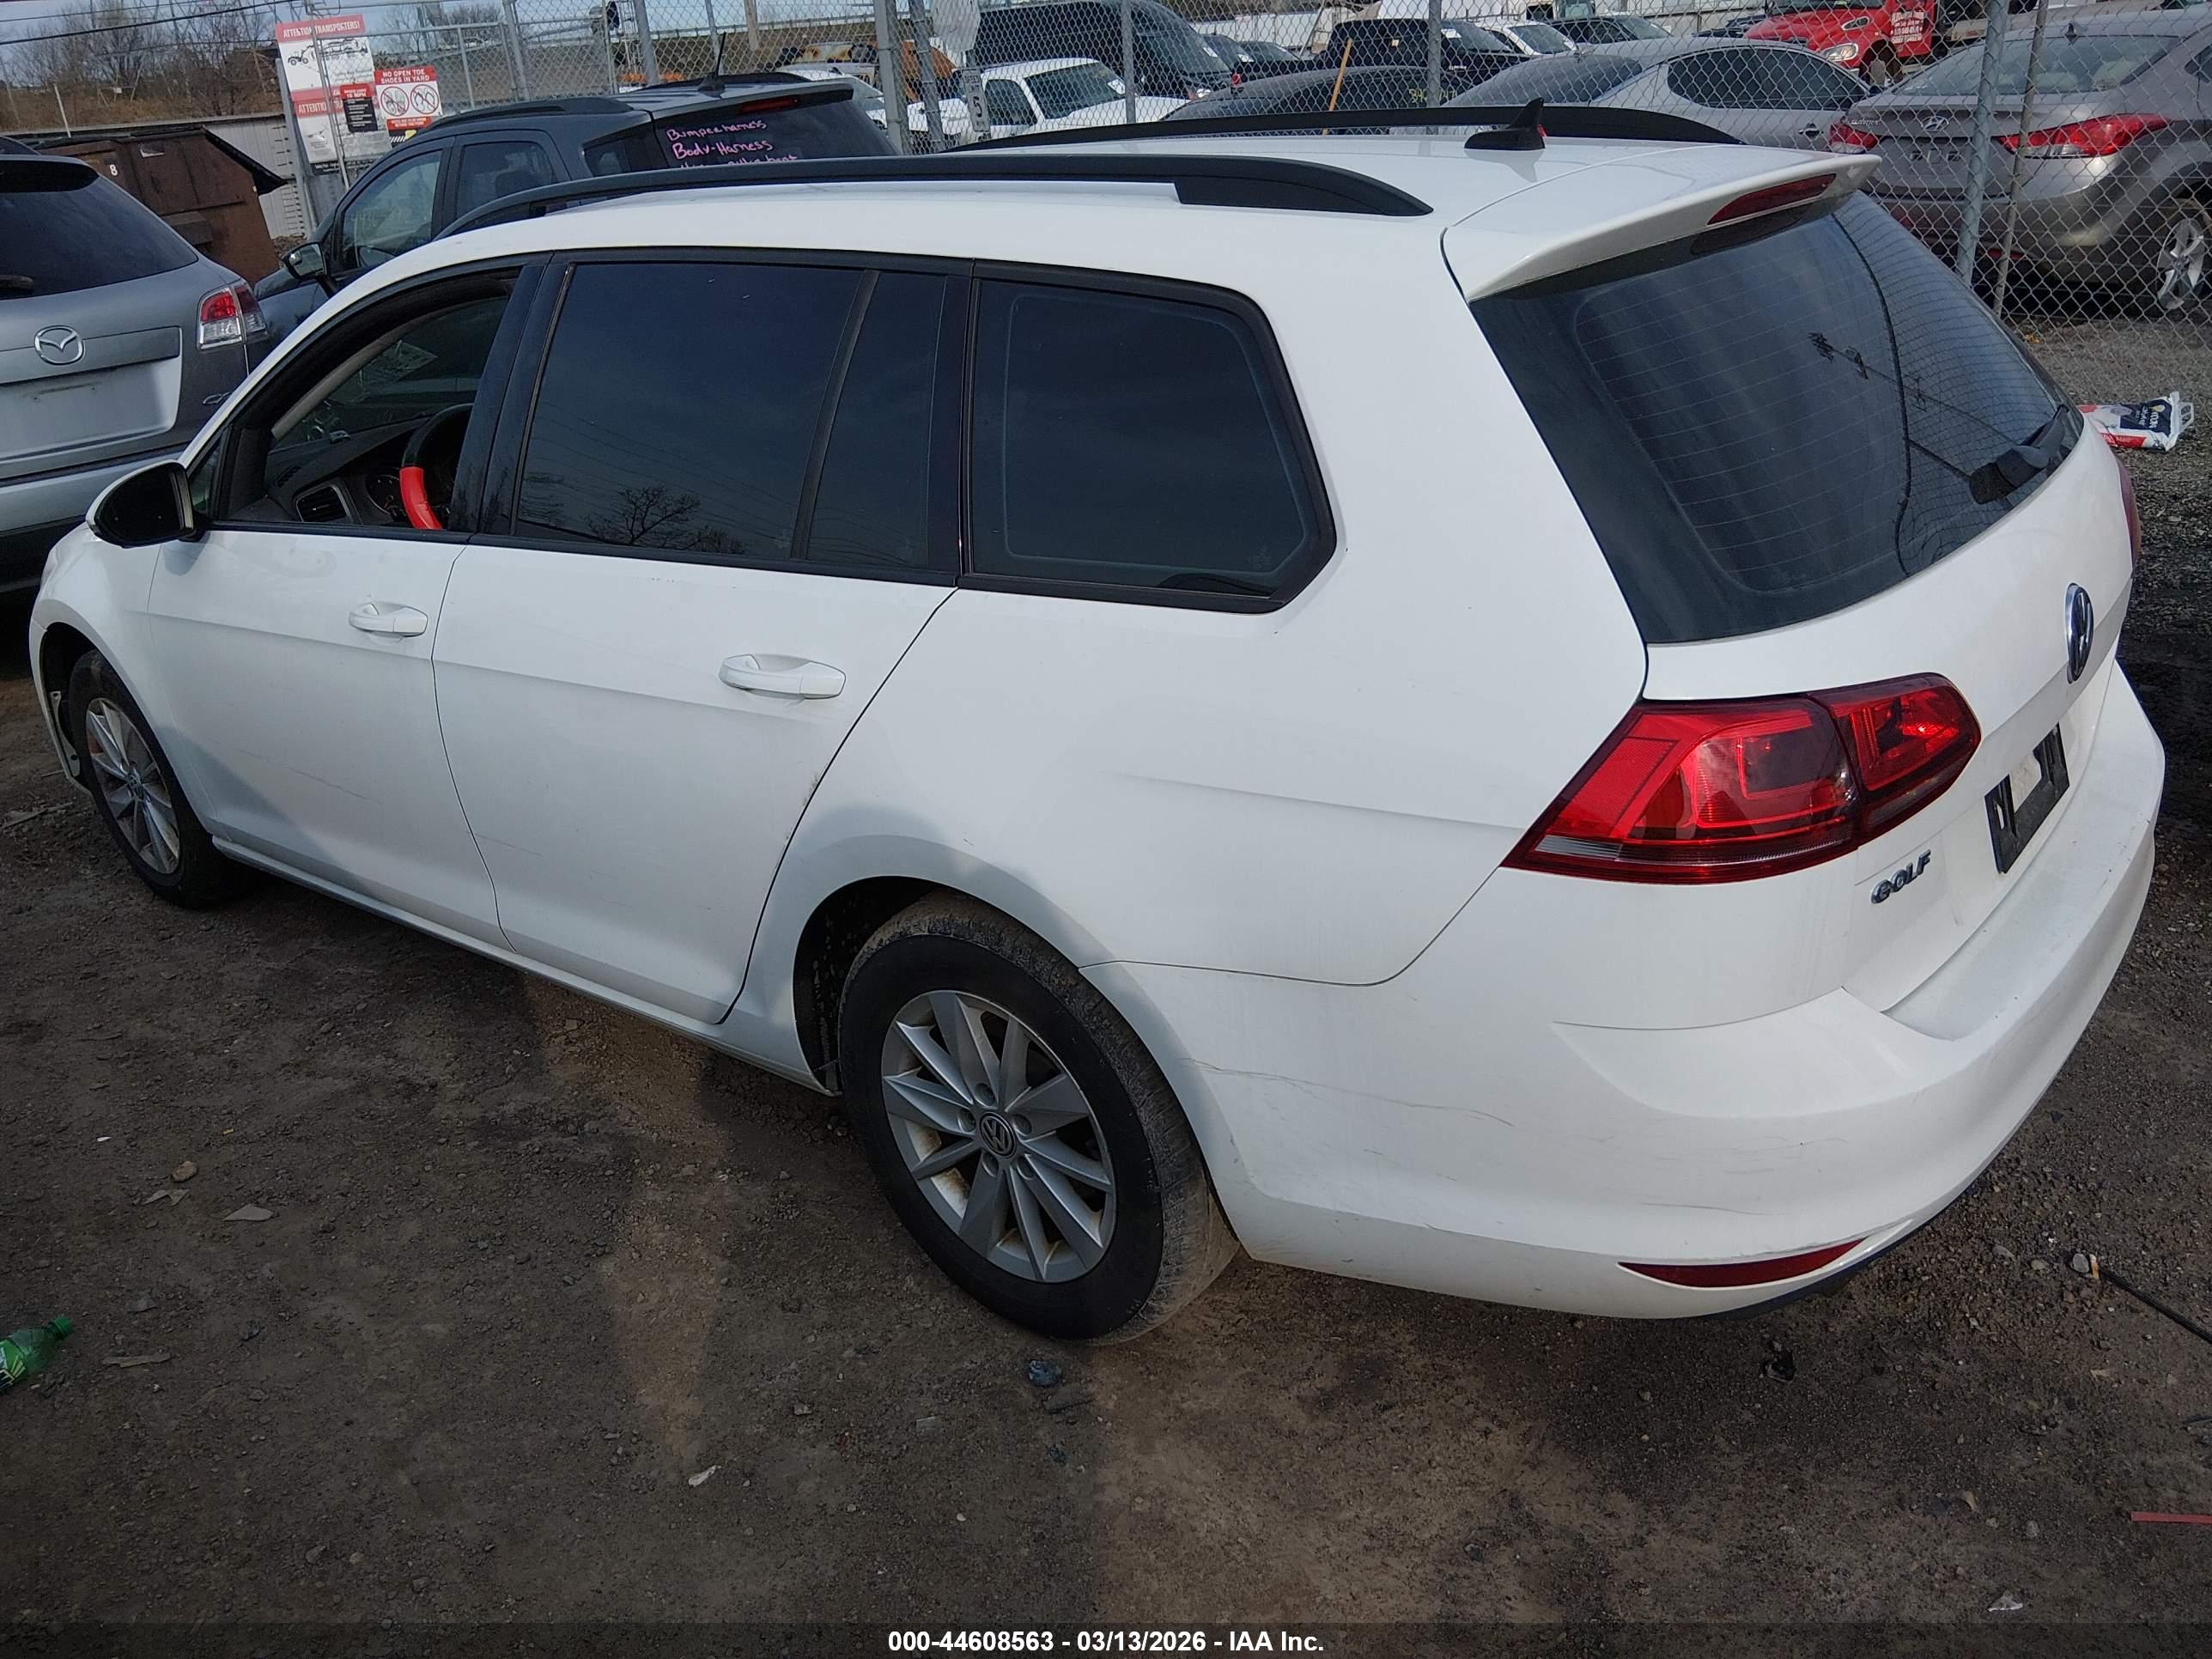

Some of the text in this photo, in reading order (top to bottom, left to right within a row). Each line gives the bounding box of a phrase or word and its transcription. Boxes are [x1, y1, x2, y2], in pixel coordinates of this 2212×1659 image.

[314, 20, 361, 33] TRANSPORTERS!
[393, 69, 411, 77] OPEN
[298, 101, 327, 114] ATTENTIO
[110, 164, 118, 176] 8
[1870, 848, 1931, 904] GOLF
